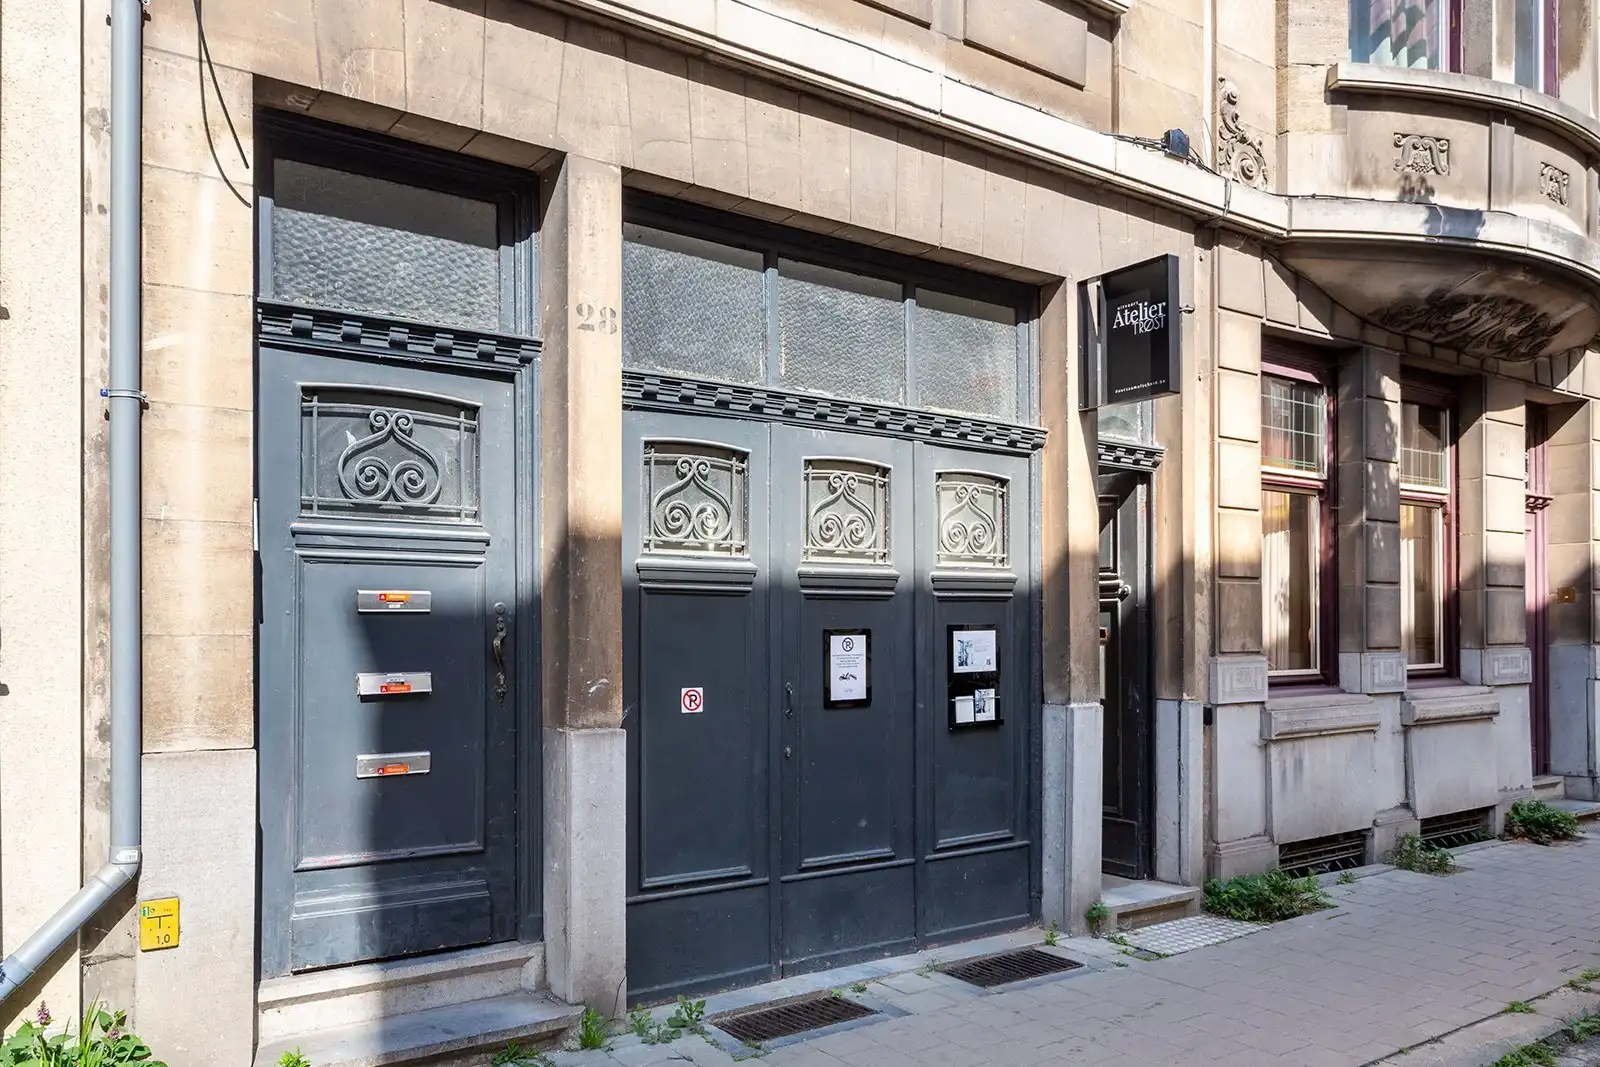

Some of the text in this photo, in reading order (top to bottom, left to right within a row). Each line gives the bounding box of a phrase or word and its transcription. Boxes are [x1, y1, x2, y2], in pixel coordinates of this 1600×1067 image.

[576, 303, 617, 335] 28
[1112, 301, 1166, 329] Atelier
[1132, 314, 1166, 335] TRØST
